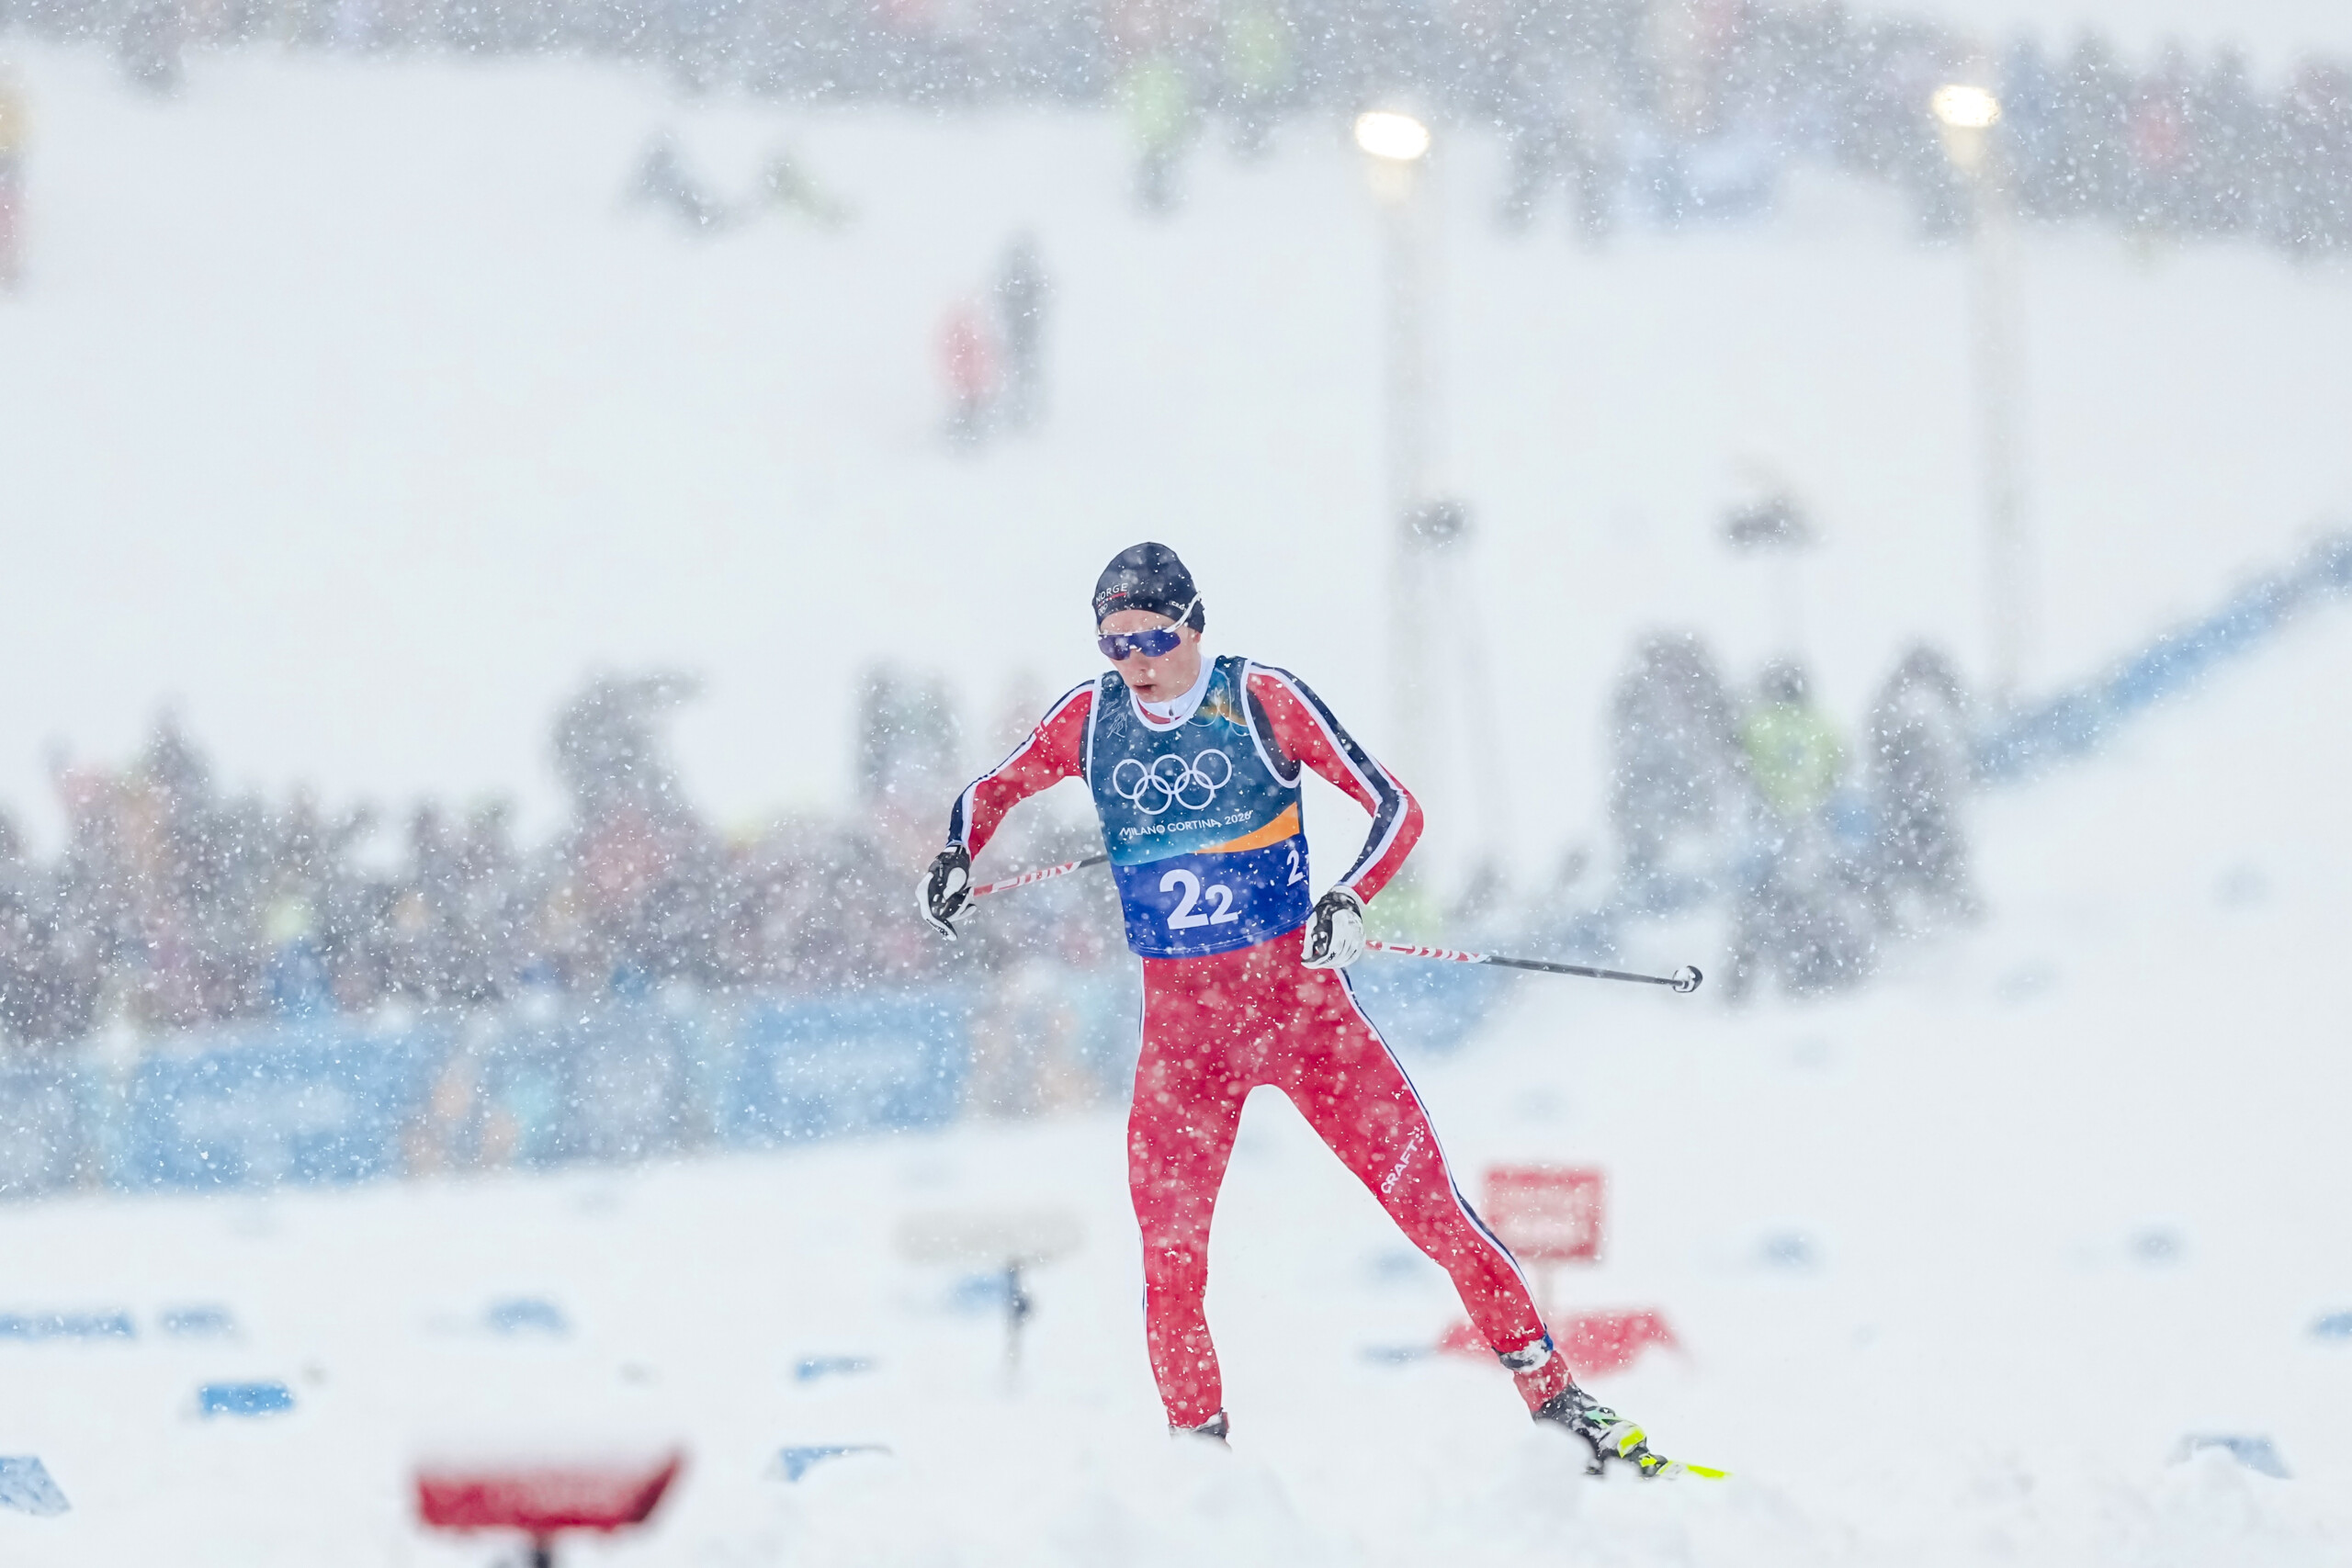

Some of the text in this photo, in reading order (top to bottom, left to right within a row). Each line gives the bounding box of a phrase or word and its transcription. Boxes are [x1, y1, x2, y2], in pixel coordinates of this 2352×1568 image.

[1095, 582, 1128, 605] NORGE
[1119, 811, 1251, 837] MILANO CORTINA 2026
[1159, 869, 1238, 930] 22
[1381, 1139, 1418, 1194] CRAFT
